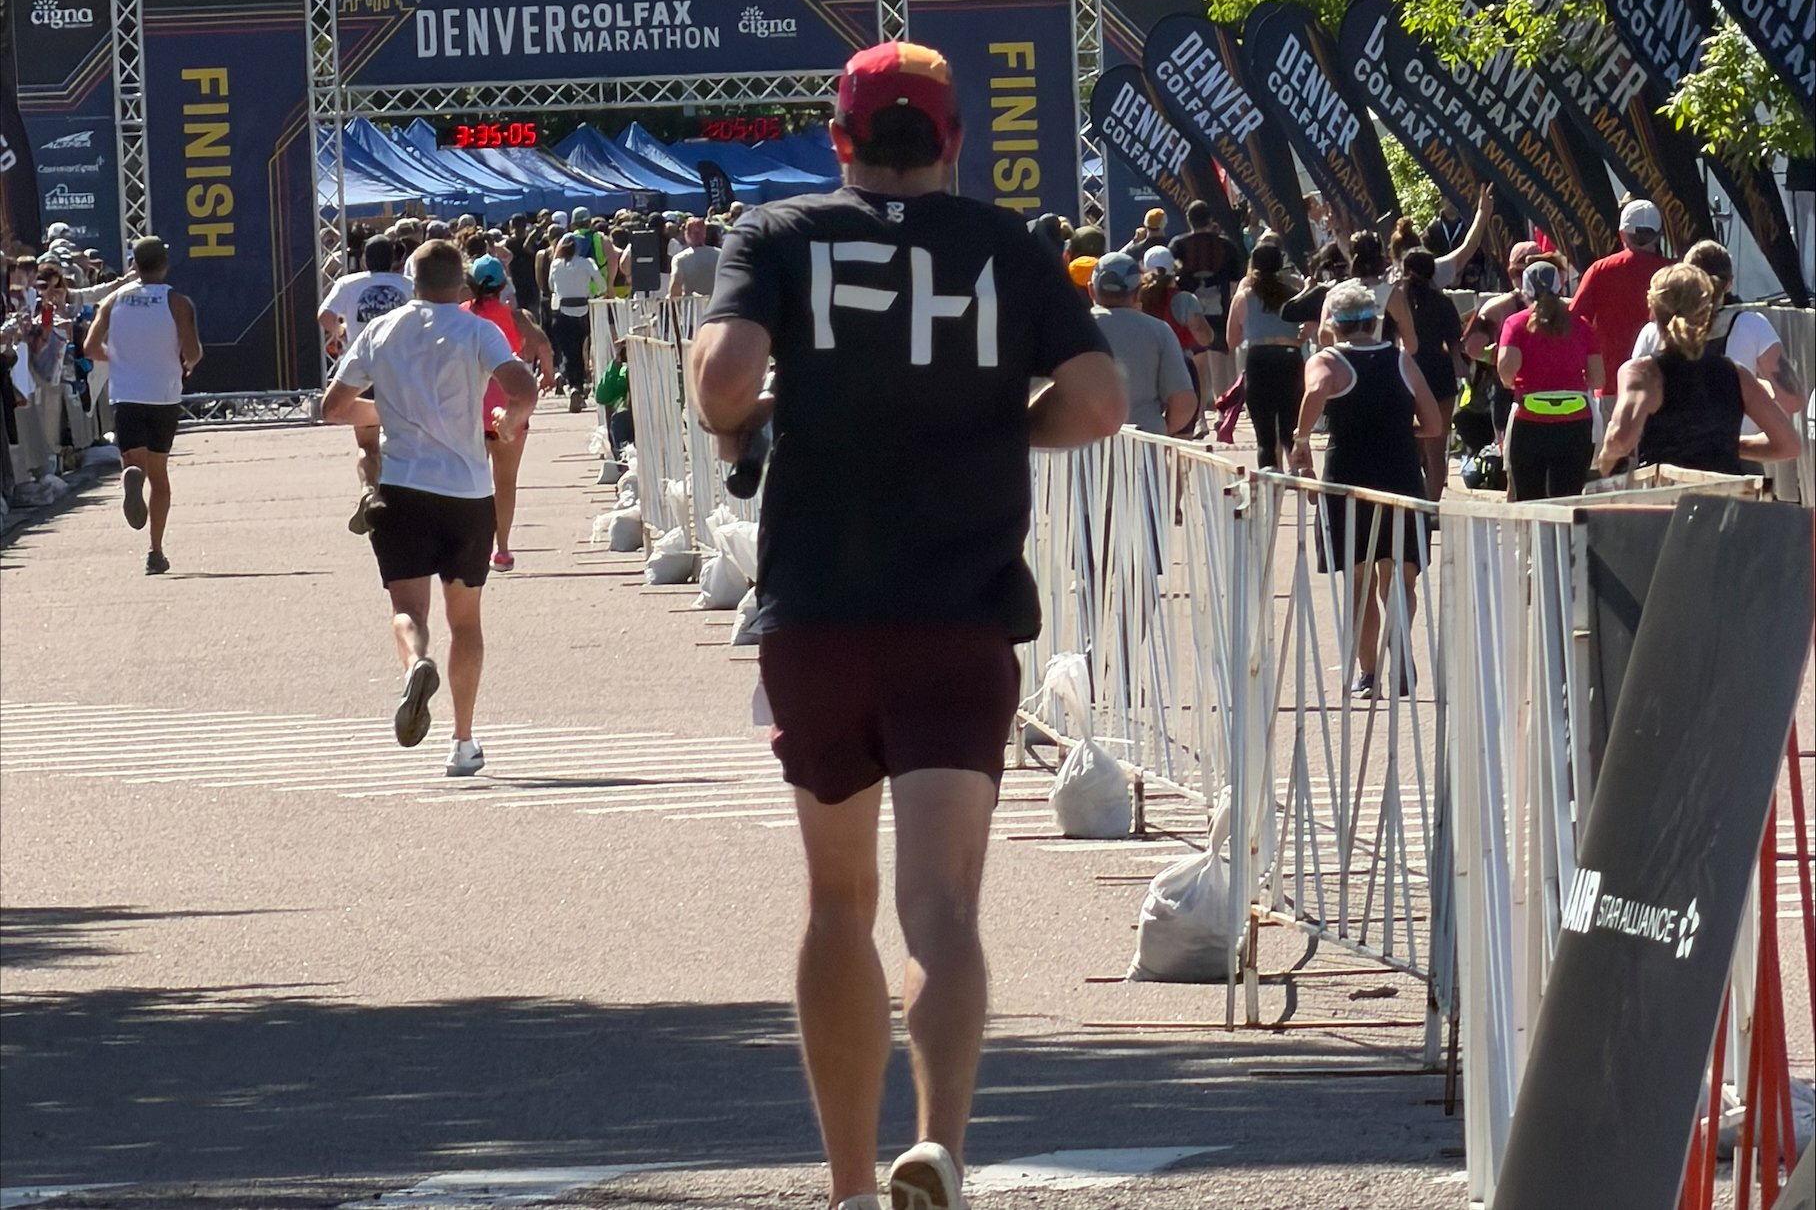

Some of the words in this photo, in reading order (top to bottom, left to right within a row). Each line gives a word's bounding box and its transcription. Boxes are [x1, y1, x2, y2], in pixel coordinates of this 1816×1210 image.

[31, 8, 93, 29] cigna
[416, 5, 567, 58] DENVER
[571, 0, 692, 29] COLFAX
[573, 26, 720, 53] MARATHON
[738, 18, 797, 38] cigna
[1111, 81, 1191, 176] DENVER
[1156, 60, 1224, 142] COLFAX
[1170, 30, 1265, 144] DENVER
[1268, 71, 1331, 157] COLFAX
[1276, 33, 1360, 155] DENVER
[1354, 57, 1433, 148] COLFAX
[1404, 58, 1487, 148] COLFAX
[181, 67, 235, 258] FINISH
[1102, 115, 1162, 181] COLFAX
[1593, 103, 1697, 244] MARATHON
[1517, 130, 1618, 253] MARATHON
[1596, 894, 1623, 930] STAR
[1617, 899, 1678, 943] ALLIANCE
